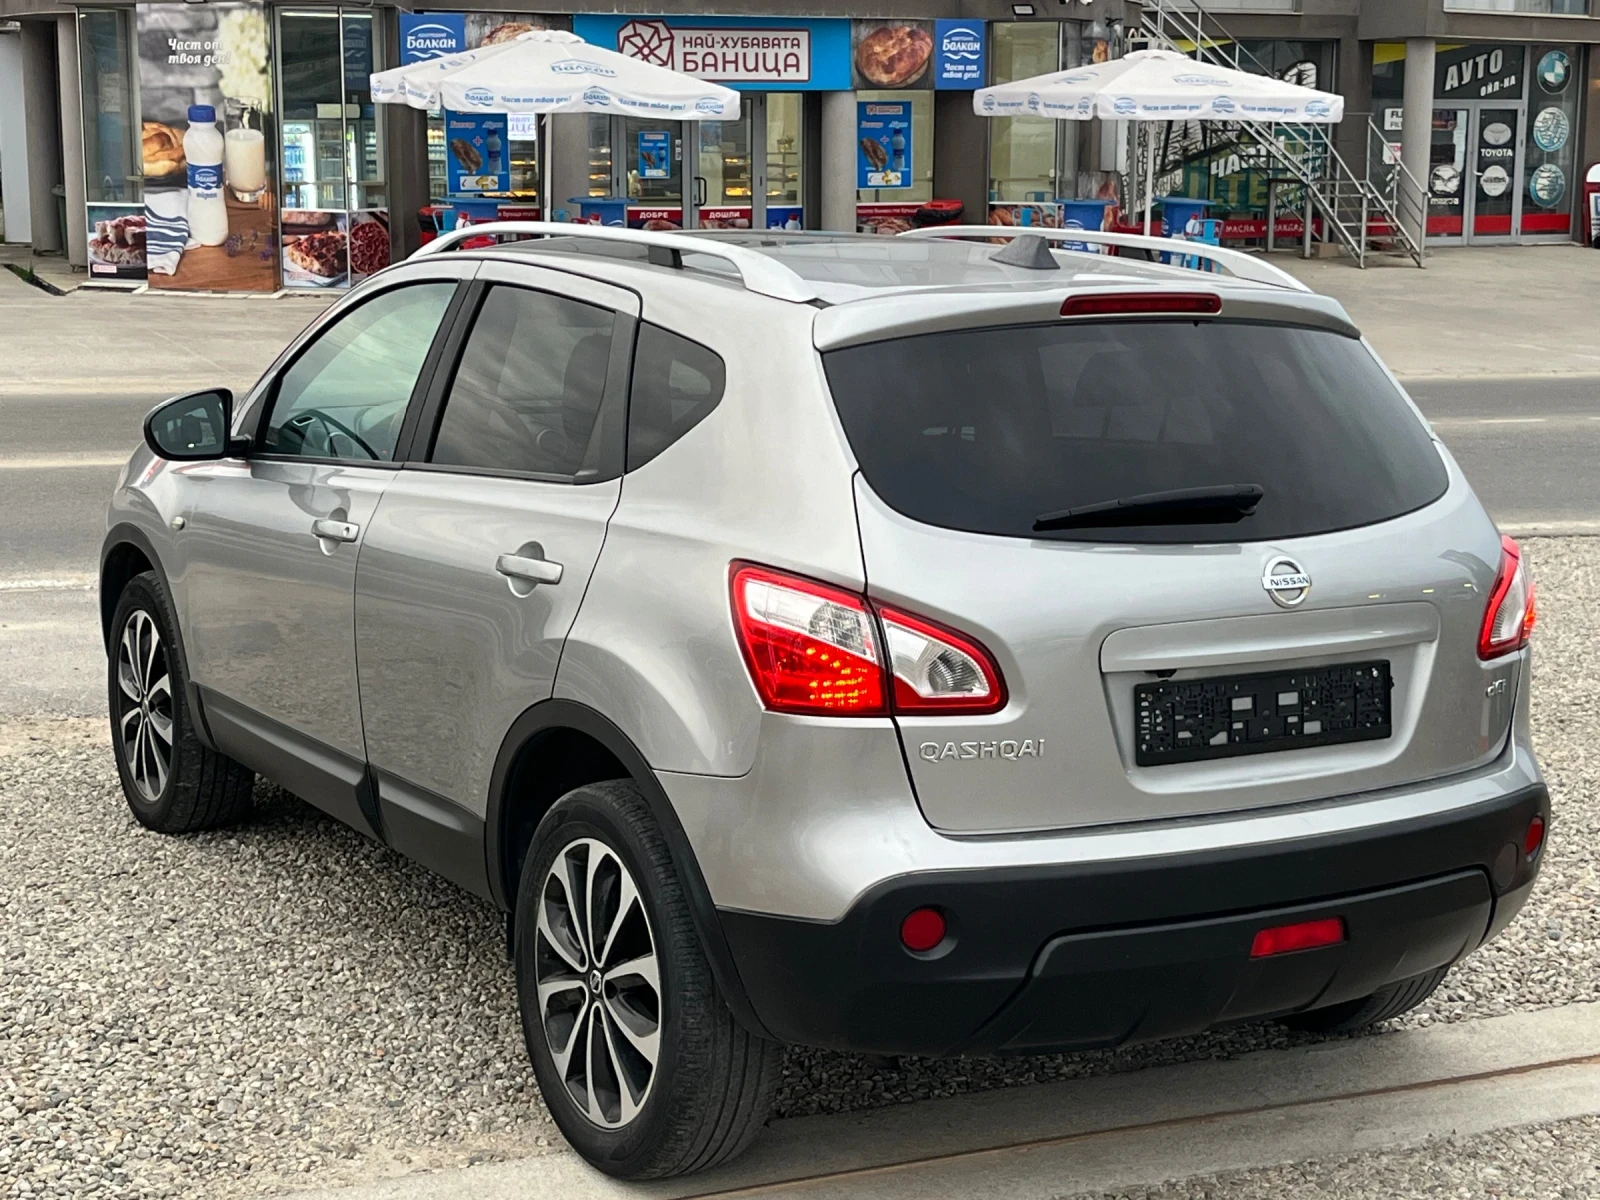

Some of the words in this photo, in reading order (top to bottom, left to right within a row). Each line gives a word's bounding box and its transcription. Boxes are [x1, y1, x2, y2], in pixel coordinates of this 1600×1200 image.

[168, 38, 202, 51] Част
[203, 41, 223, 51] от
[407, 36, 456, 49] Балкан
[682, 33, 801, 49] НАЙ-ХУБАВАТА
[942, 39, 980, 51] Балкан
[168, 53, 202, 64] твоя
[683, 51, 801, 77] БАНИЦА
[1444, 48, 1504, 92] АУТО
[465, 93, 494, 102] Балкан
[583, 92, 611, 101] Балкан
[1480, 148, 1513, 157] TOYOTA
[639, 211, 669, 219] ДОБРЕ
[709, 211, 741, 219] ДОШЛИ
[1225, 225, 1256, 233] МАСЛА
[1270, 576, 1309, 587] NISSAN
[918, 739, 1046, 764] QASHQAI
